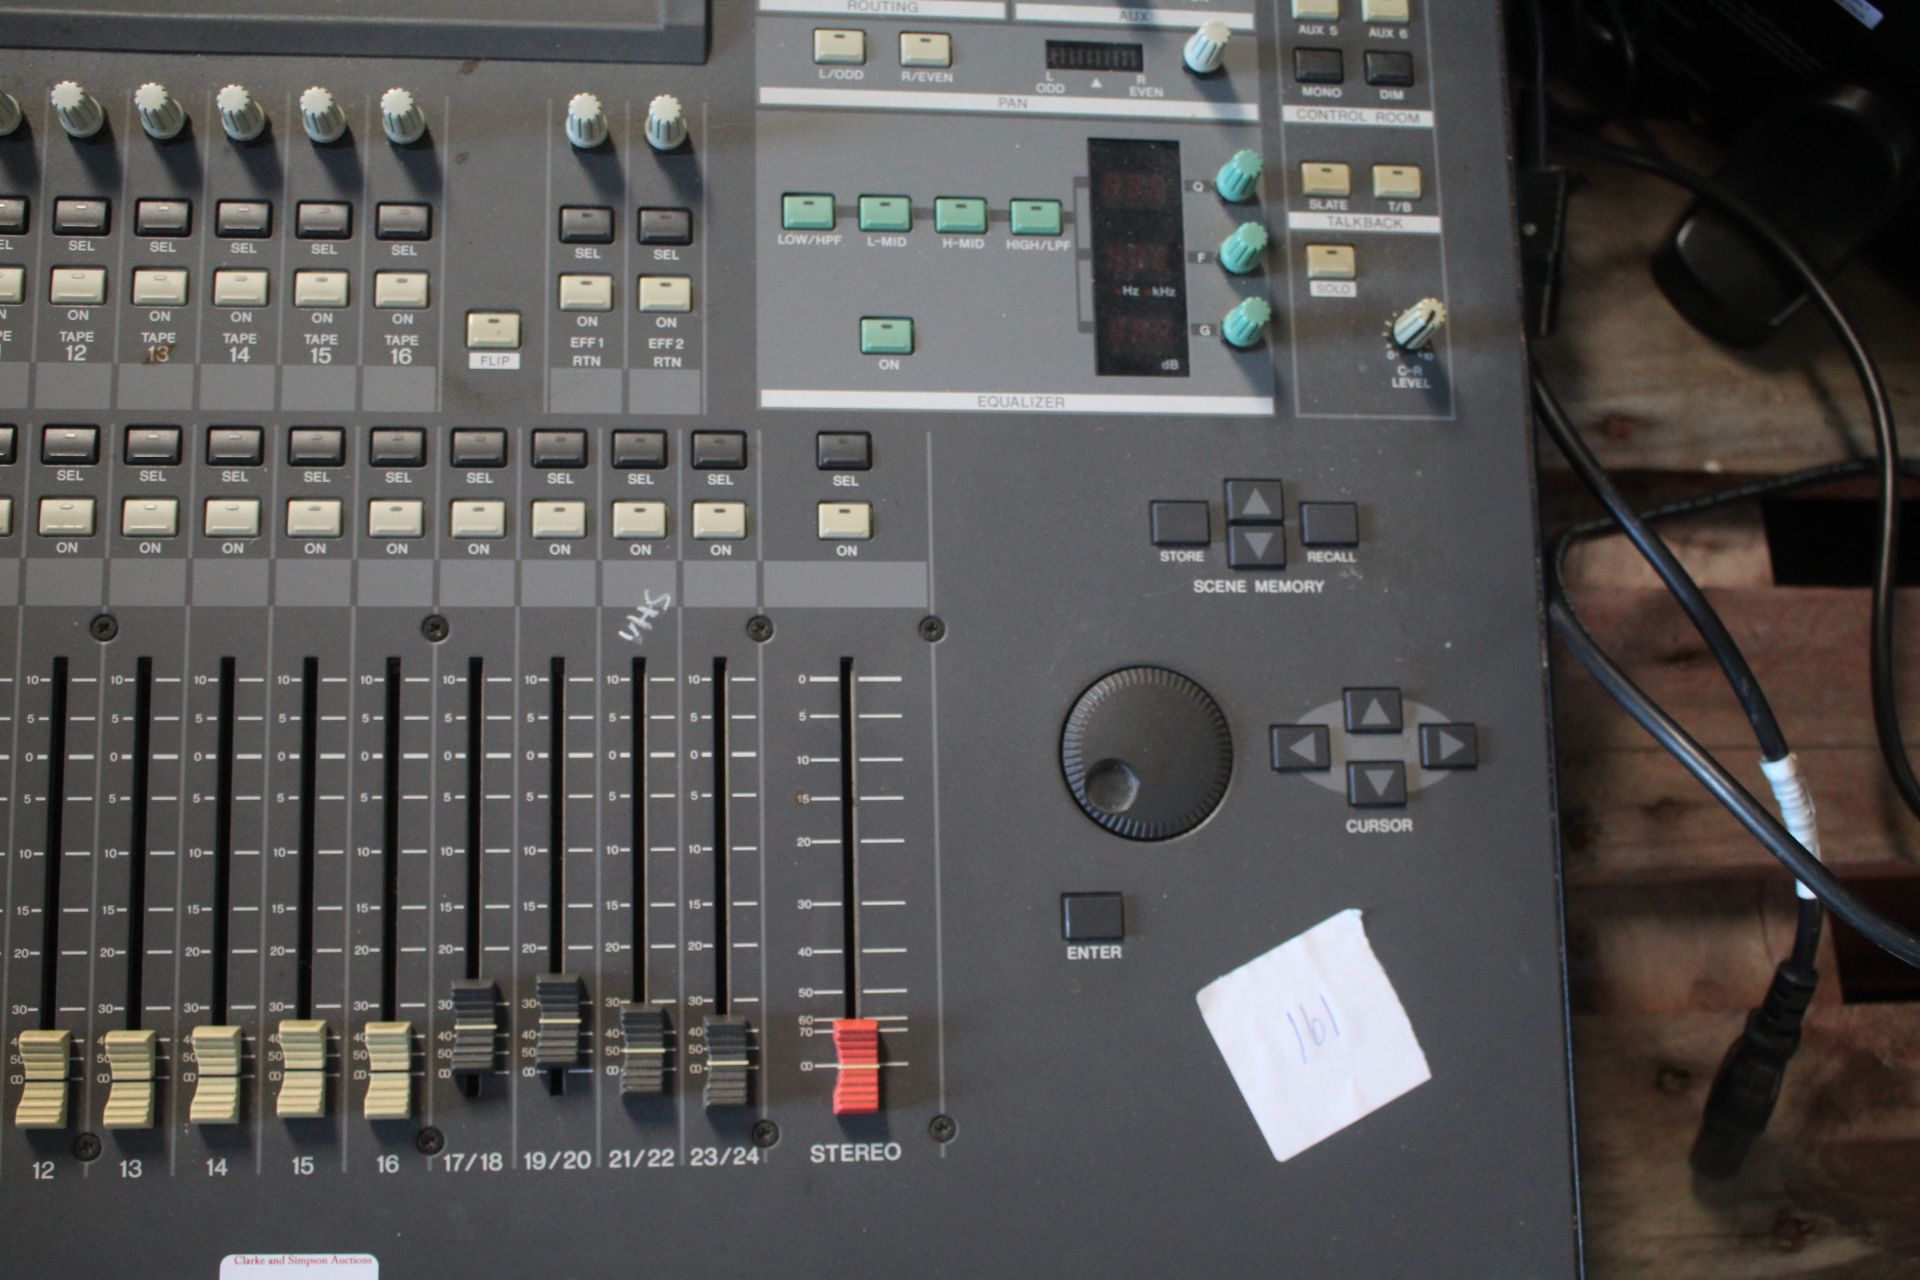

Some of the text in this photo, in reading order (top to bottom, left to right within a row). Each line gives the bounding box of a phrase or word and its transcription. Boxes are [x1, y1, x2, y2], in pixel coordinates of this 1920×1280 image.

[847, 0, 919, 13] ROUTING
[1120, 9, 1148, 21] AUX
[1298, 25, 1324, 36] AUX
[1368, 27, 1395, 39] AUX
[819, 69, 864, 81] L/ODD
[902, 71, 953, 83] R/EVEN
[1046, 72, 1054, 82] L
[1136, 75, 1146, 86] R
[1036, 83, 1066, 94] ODD
[1129, 86, 1164, 98] EVEN
[1302, 86, 1342, 98] MONO
[1379, 89, 1404, 100] DIM
[998, 97, 1028, 109] PAN
[1296, 109, 1420, 124] CONTROL ROOM
[1309, 200, 1348, 211] SLATE
[1387, 202, 1412, 213] T/B
[1328, 215, 1404, 229] TALKBACK
[778, 233, 843, 246] LOW/HPF
[867, 236, 907, 248] L-MID
[942, 238, 985, 250] H-MID
[68, 240, 95, 252] SEL
[150, 241, 176, 253] SEL
[231, 242, 257, 254] SEL
[311, 243, 338, 255] SEL
[391, 244, 418, 256] SEL
[1006, 240, 1071, 252] HIGH/LPF
[574, 248, 601, 260] SEL
[653, 249, 680, 261] SEL
[1197, 253, 1206, 263] F
[1122, 285, 1176, 298] Hz kHz
[1316, 284, 1351, 295] SOLO
[67, 309, 89, 322] ON
[149, 310, 171, 322] ON
[230, 311, 252, 323] ON
[311, 312, 333, 324] ON
[392, 313, 414, 325] ON
[577, 316, 598, 328] ON
[656, 317, 677, 329] ON
[1200, 325, 1210, 336] G
[59, 331, 94, 343] TAPE
[141, 332, 176, 344] TAPE
[222, 333, 257, 345] TAPE
[304, 334, 339, 345] TAPE
[384, 335, 419, 346] TAPE
[570, 337, 604, 349] EFF 1
[648, 338, 684, 350] EFF 2
[65, 345, 87, 362] 12
[149, 345, 170, 362] 13
[229, 346, 250, 363] 14
[310, 347, 332, 364] 15
[390, 348, 412, 365] 16
[480, 356, 510, 367] FLIP
[573, 356, 601, 367] RTN
[653, 356, 682, 368] RTN
[878, 359, 899, 370] ON
[1161, 358, 1179, 371] dB
[1391, 377, 1432, 389] LEVEL
[977, 396, 1065, 408] EQUALIZER
[56, 470, 84, 482] SEL
[139, 470, 167, 482] SEL
[222, 471, 249, 483] SEL
[304, 471, 331, 483] SEL
[385, 472, 412, 484] SEL
[466, 472, 494, 484] SEL
[547, 473, 574, 485] SEL
[627, 473, 654, 485] SEL
[707, 474, 734, 486] SEL
[833, 475, 860, 487] SEL
[56, 542, 78, 554] ON
[139, 542, 161, 554] ON
[222, 542, 244, 554] ON
[304, 543, 326, 554] ON
[386, 543, 408, 555] ON
[468, 543, 490, 555] ON
[549, 544, 571, 556] ON
[630, 544, 652, 556] ON
[710, 544, 732, 556] ON
[836, 545, 858, 557] ON
[1160, 551, 1205, 563] STORE
[1307, 551, 1357, 563] RECALL
[1193, 579, 1325, 593] SCENE MEMORY
[618, 589, 671, 645] VHS
[26, 675, 39, 685] 10
[194, 675, 207, 685] 10
[443, 675, 455, 685] 10
[688, 675, 700, 685] 10
[798, 674, 806, 684] 0
[27, 714, 35, 724] 5
[195, 714, 203, 724] 5
[444, 713, 452, 723] 5
[690, 712, 698, 722] 5
[799, 711, 807, 721] 5
[25, 752, 33, 762] 0
[193, 752, 202, 762] 0
[443, 751, 452, 761] 0
[689, 750, 698, 760] 0
[797, 755, 809, 765] 10
[23, 794, 32, 804] 5
[193, 793, 201, 803] 5
[443, 792, 451, 802] 5
[690, 790, 698, 800] 5
[797, 794, 810, 804] 15
[1346, 818, 1413, 833] CURSOR
[796, 837, 811, 847] 20
[19, 849, 32, 858] 10
[189, 848, 201, 858] 10
[440, 846, 454, 857] 10
[688, 844, 701, 854] 10
[187, 905, 200, 915] 15
[439, 902, 453, 912] 15
[688, 900, 701, 910] 15
[797, 899, 812, 910] 30
[16, 906, 30, 916] 15
[438, 944, 453, 954] 20
[688, 941, 703, 951] 20
[798, 947, 813, 957] 40
[14, 948, 29, 958] 20
[1067, 945, 1122, 960] ENTER
[798, 988, 813, 998] 50
[438, 1000, 453, 1010] 30
[688, 996, 703, 1006] 30
[11, 1005, 27, 1015] 30
[798, 1015, 813, 1025] 60
[800, 1027, 814, 1037] 70
[1286, 994, 1340, 1065] 161
[609, 1149, 675, 1168] 21/22
[690, 1147, 760, 1166] 23/24
[810, 1142, 902, 1163] STEREO
[291, 1156, 315, 1175] 15
[376, 1155, 399, 1173] 16
[443, 1153, 503, 1172] 17/18
[524, 1151, 592, 1170] 19/20
[32, 1161, 55, 1179] 12
[119, 1159, 142, 1178] 13
[205, 1158, 228, 1177] 14
[234, 1255, 372, 1267] Clarke and Simpson Auctions
